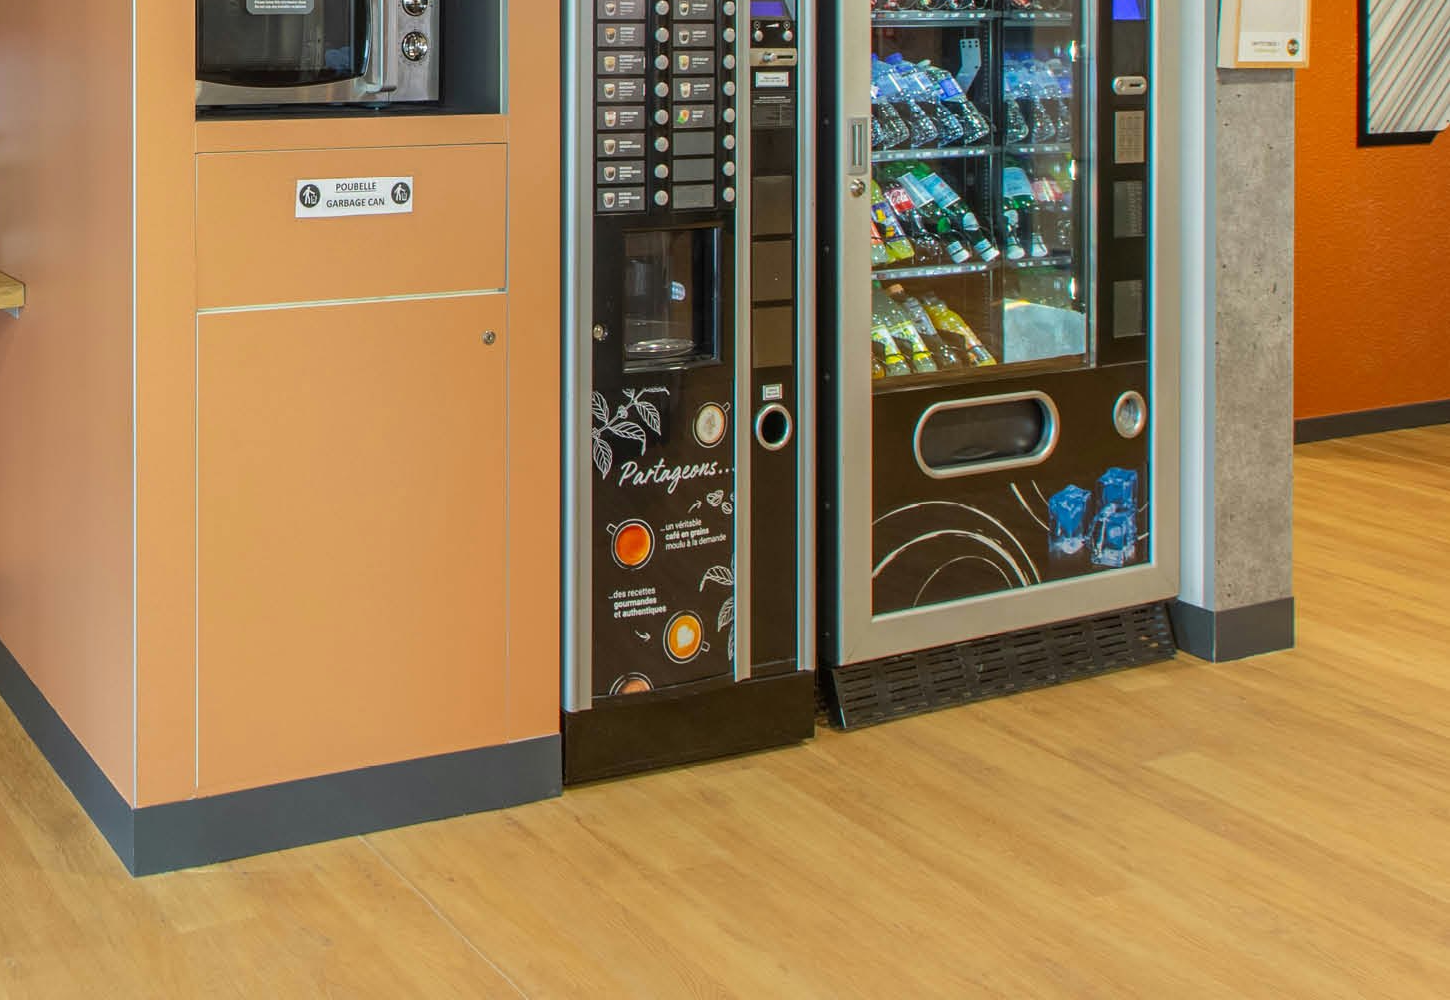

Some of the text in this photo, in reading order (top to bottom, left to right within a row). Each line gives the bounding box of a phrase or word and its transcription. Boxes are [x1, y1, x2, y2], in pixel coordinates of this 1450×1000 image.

[335, 182, 377, 192] POUBELLE
[326, 197, 385, 208] GARBAGE CAN
[675, 518, 702, 530] véritable
[665, 532, 680, 541] café
[690, 527, 709, 538] grains
[665, 541, 686, 550] moulu
[692, 538, 698, 546] la
[698, 533, 727, 545] demande
[627, 587, 656, 598] recettes
[614, 597, 657, 610] gourmandes
[614, 605, 667, 619] et authentiques
